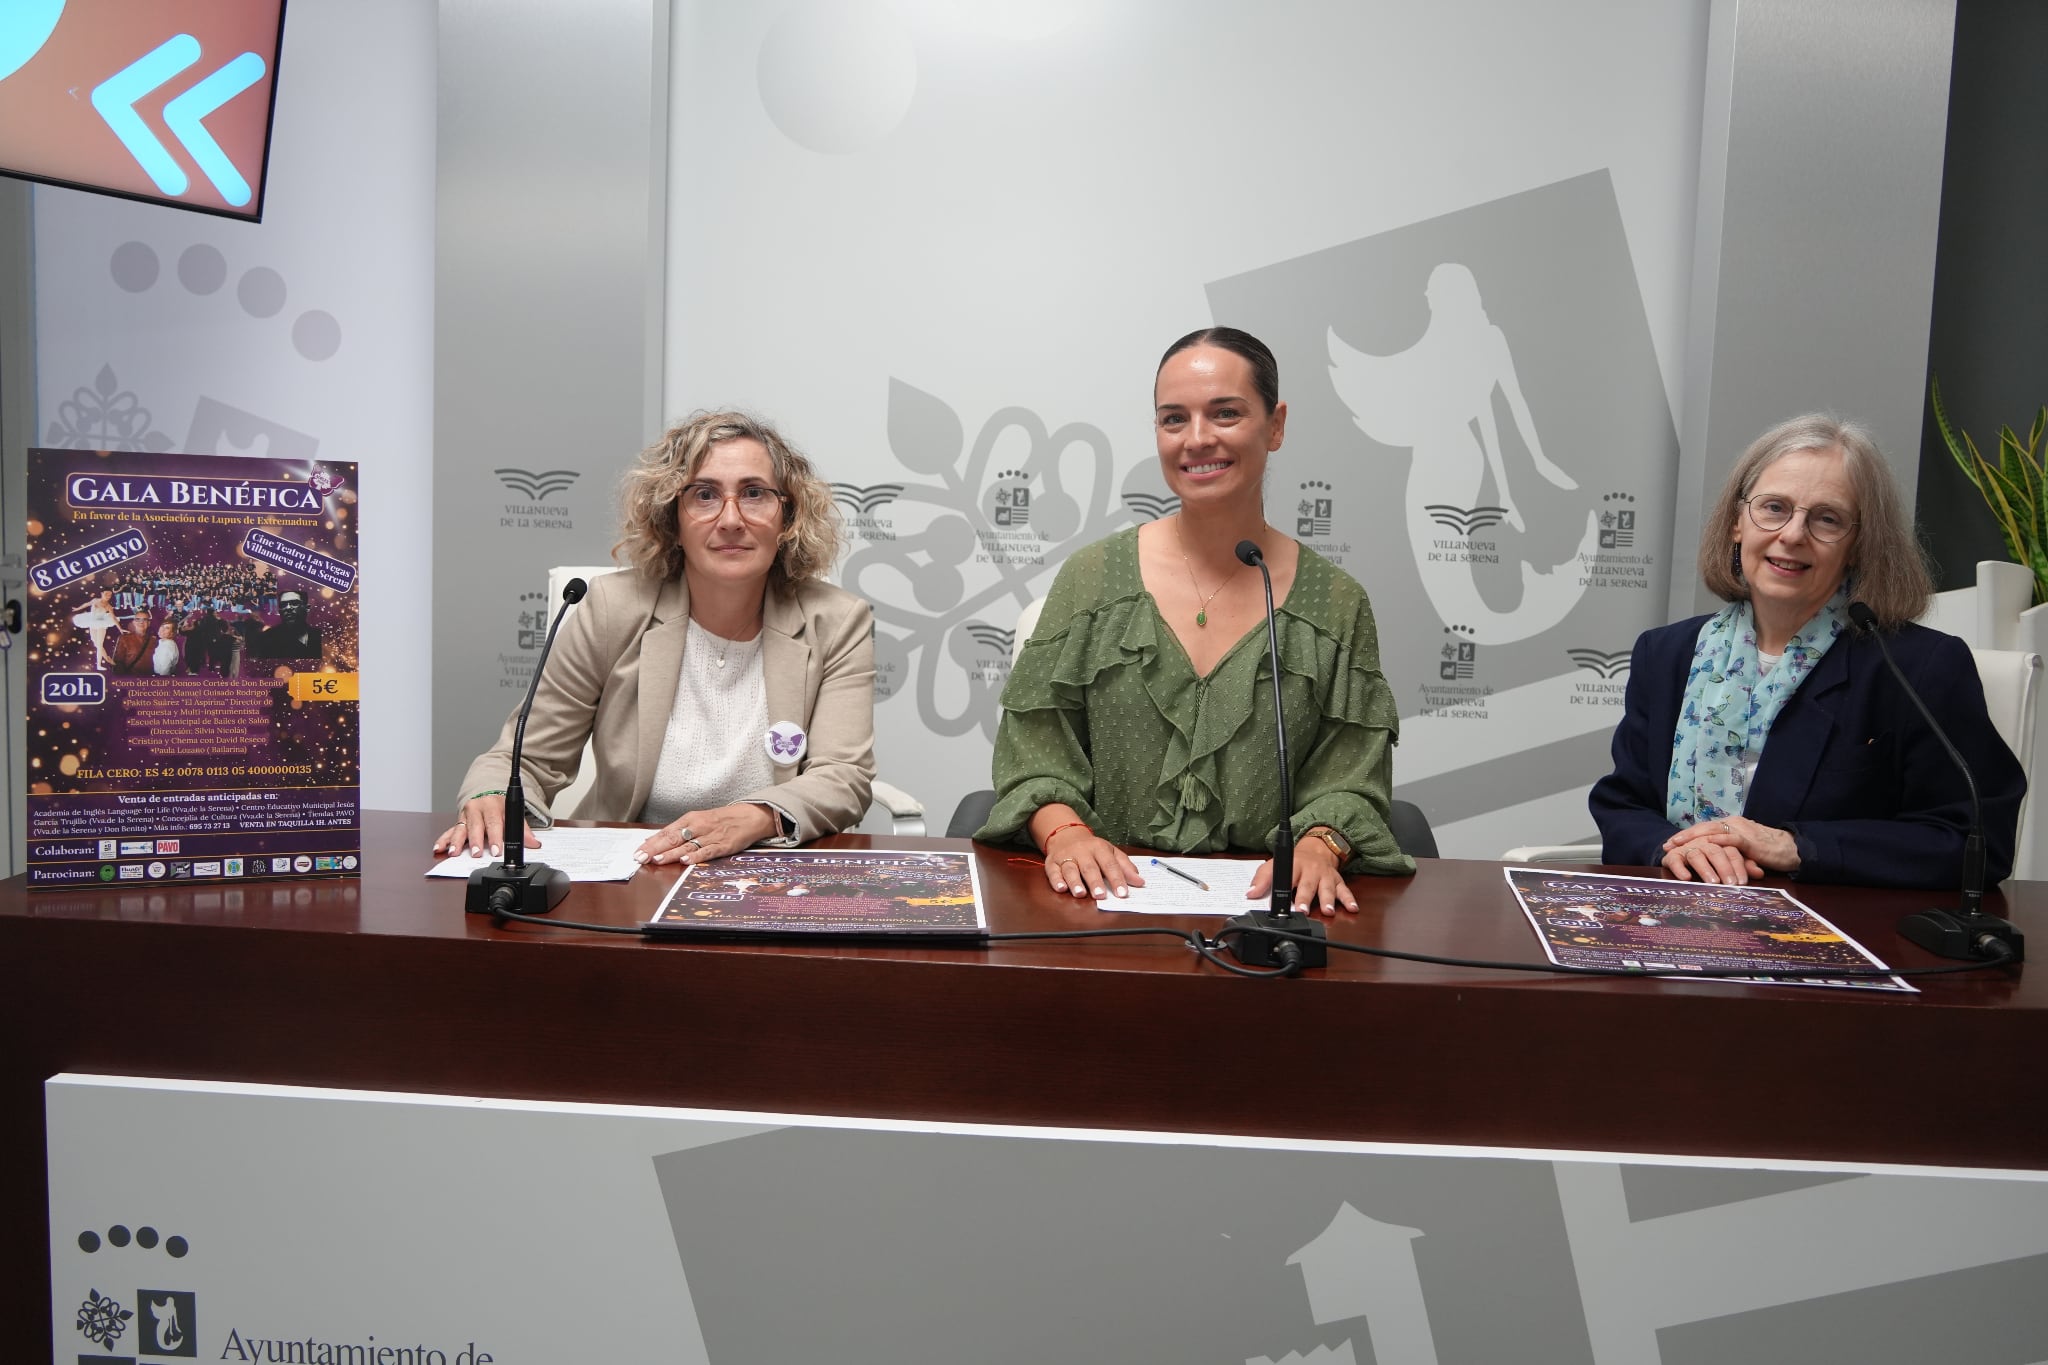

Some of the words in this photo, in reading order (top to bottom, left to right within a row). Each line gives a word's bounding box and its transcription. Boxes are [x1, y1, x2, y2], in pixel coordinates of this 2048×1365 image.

[71, 478, 161, 504] GALA
[170, 481, 320, 509] BENÉFICA
[73, 511, 87, 520] En
[89, 511, 115, 521] favor
[118, 512, 130, 522] de
[131, 513, 141, 522] la
[142, 514, 195, 524] Asociación
[198, 515, 210, 524] de
[211, 516, 241, 528] Lupus
[243, 517, 255, 526] de
[257, 517, 319, 528] Extremadura
[975, 529, 1035, 543] Ayuntamiento
[1037, 530, 1049, 541] de
[1340, 542, 1352, 553] de
[36, 569, 53, 587] 8
[56, 560, 83, 580] de
[85, 537, 143, 569] mayo
[251, 532, 276, 548] Cine
[276, 541, 307, 561] Teatro
[307, 555, 323, 568] Las
[324, 561, 351, 579] Vegas
[1577, 552, 1641, 565] Ayuntamiento
[1642, 554, 1654, 565] de
[245, 540, 295, 567] Villanueva
[294, 560, 307, 572] de
[307, 566, 318, 576] la
[317, 569, 351, 589] Serena
[48, 678, 99, 697] 20h.
[259, 679, 284, 687] Benito
[312, 679, 339, 695] 5€
[1419, 683, 1482, 697] Ayuntamiento
[1482, 685, 1494, 696] de
[1575, 683, 1625, 694] VILLANUE
[137, 709, 172, 718] orquesta
[162, 718, 201, 728] Municipal
[202, 718, 212, 726] de
[213, 718, 236, 726] Bailes
[237, 717, 248, 725] de
[248, 717, 270, 725] Salón
[77, 769, 105, 779] FILA
[107, 768, 142, 778] CERO:
[145, 768, 159, 778] ES
[161, 768, 175, 777] 42
[177, 767, 204, 777] 0078
[206, 766, 229, 776] 0113
[231, 766, 245, 776] 05
[247, 765, 312, 775] 4000000135
[118, 795, 147, 804] Venta
[149, 795, 161, 803] de
[163, 793, 206, 803] entradas
[207, 792, 262, 804] anticipadas
[34, 809, 70, 818] Academia
[72, 809, 82, 817] de
[83, 808, 106, 818] Inglés
[107, 808, 142, 819] Language
[207, 805, 235, 814] Serena)
[267, 803, 301, 811] Educativo
[302, 802, 336, 811] Municipal
[336, 800, 355, 808] Jesús
[60, 818, 87, 828] Trujillo
[126, 816, 154, 825] Serena)
[211, 813, 238, 821] Cultura
[274, 811, 301, 821] Serena)
[70, 827, 97, 835] Serena
[104, 826, 120, 834] Don
[121, 825, 148, 835] Benito)
[239, 821, 264, 829] VENTA
[278, 820, 314, 829] TAQUILLA
[327, 818, 352, 826] ANTES
[35, 844, 95, 856] Colaboran:
[158, 842, 179, 853] PAVO
[34, 867, 95, 881] Patrocinan:
[220, 1328, 447, 1365] Ayuntamiento
[456, 1342, 494, 1365] de
